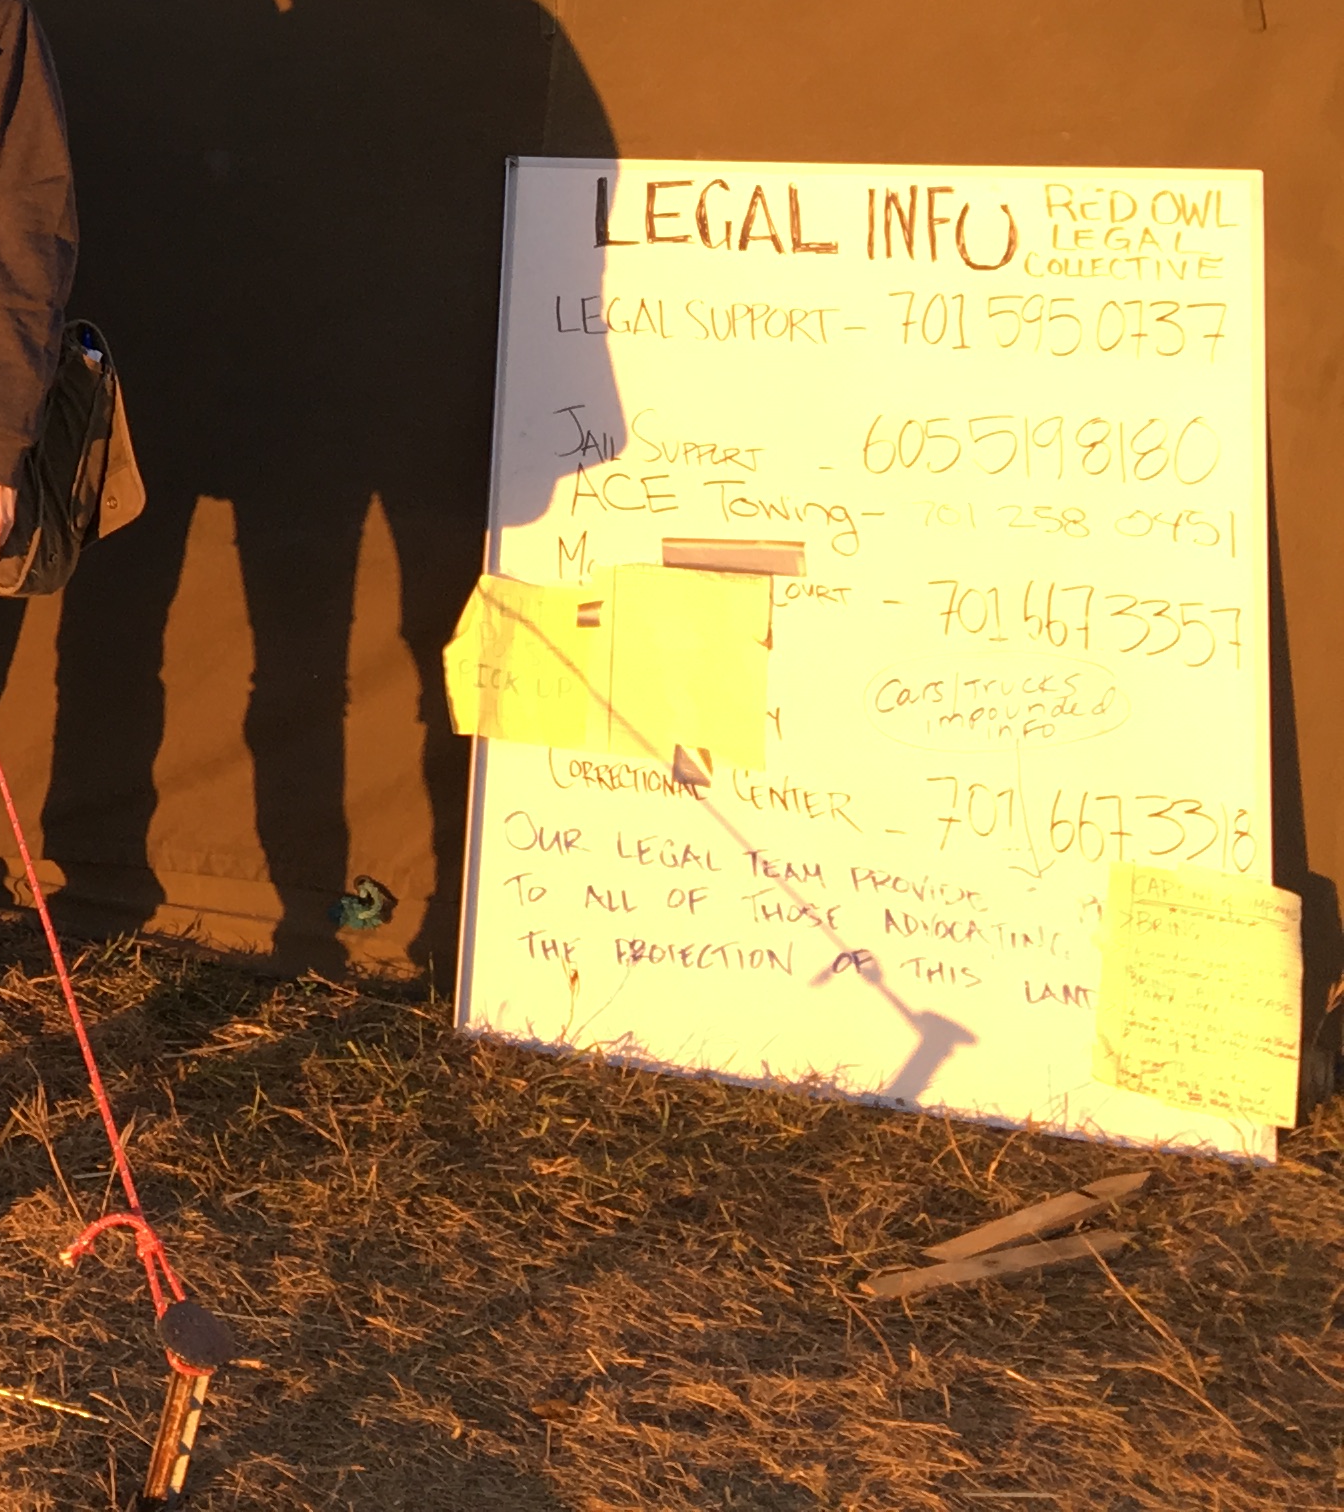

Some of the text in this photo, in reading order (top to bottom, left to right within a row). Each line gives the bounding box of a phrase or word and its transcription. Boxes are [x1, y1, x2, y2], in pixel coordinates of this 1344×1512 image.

[594, 176, 840, 255] LEGAL
[1043, 183, 1240, 229] RED OWL
[1052, 224, 1211, 255] LEGAL
[1023, 251, 1225, 281] COLLECTIVE
[555, 295, 673, 340] LEGAL
[684, 299, 841, 345] SUPPORT
[888, 291, 972, 351] 701
[1095, 299, 1227, 365] 0737
[552, 403, 622, 465] JAIL
[630, 407, 768, 473] SUPPORT
[570, 461, 680, 517] ACE
[702, 479, 861, 557] Towing
[912, 500, 978, 531] 701
[996, 503, 1092, 539] 258
[927, 579, 1009, 643] 701
[1105, 593, 1242, 671] 3357
[503, 810, 592, 857] OUR
[615, 831, 723, 873] LEGAL
[742, 849, 827, 889] TEAM
[502, 872, 548, 907] TO
[584, 885, 639, 914] ALL
[666, 886, 710, 916] OF
[740, 886, 842, 931] THOSE
[516, 929, 582, 964] THE
[831, 948, 874, 975] OF
[898, 957, 984, 989] THIS
